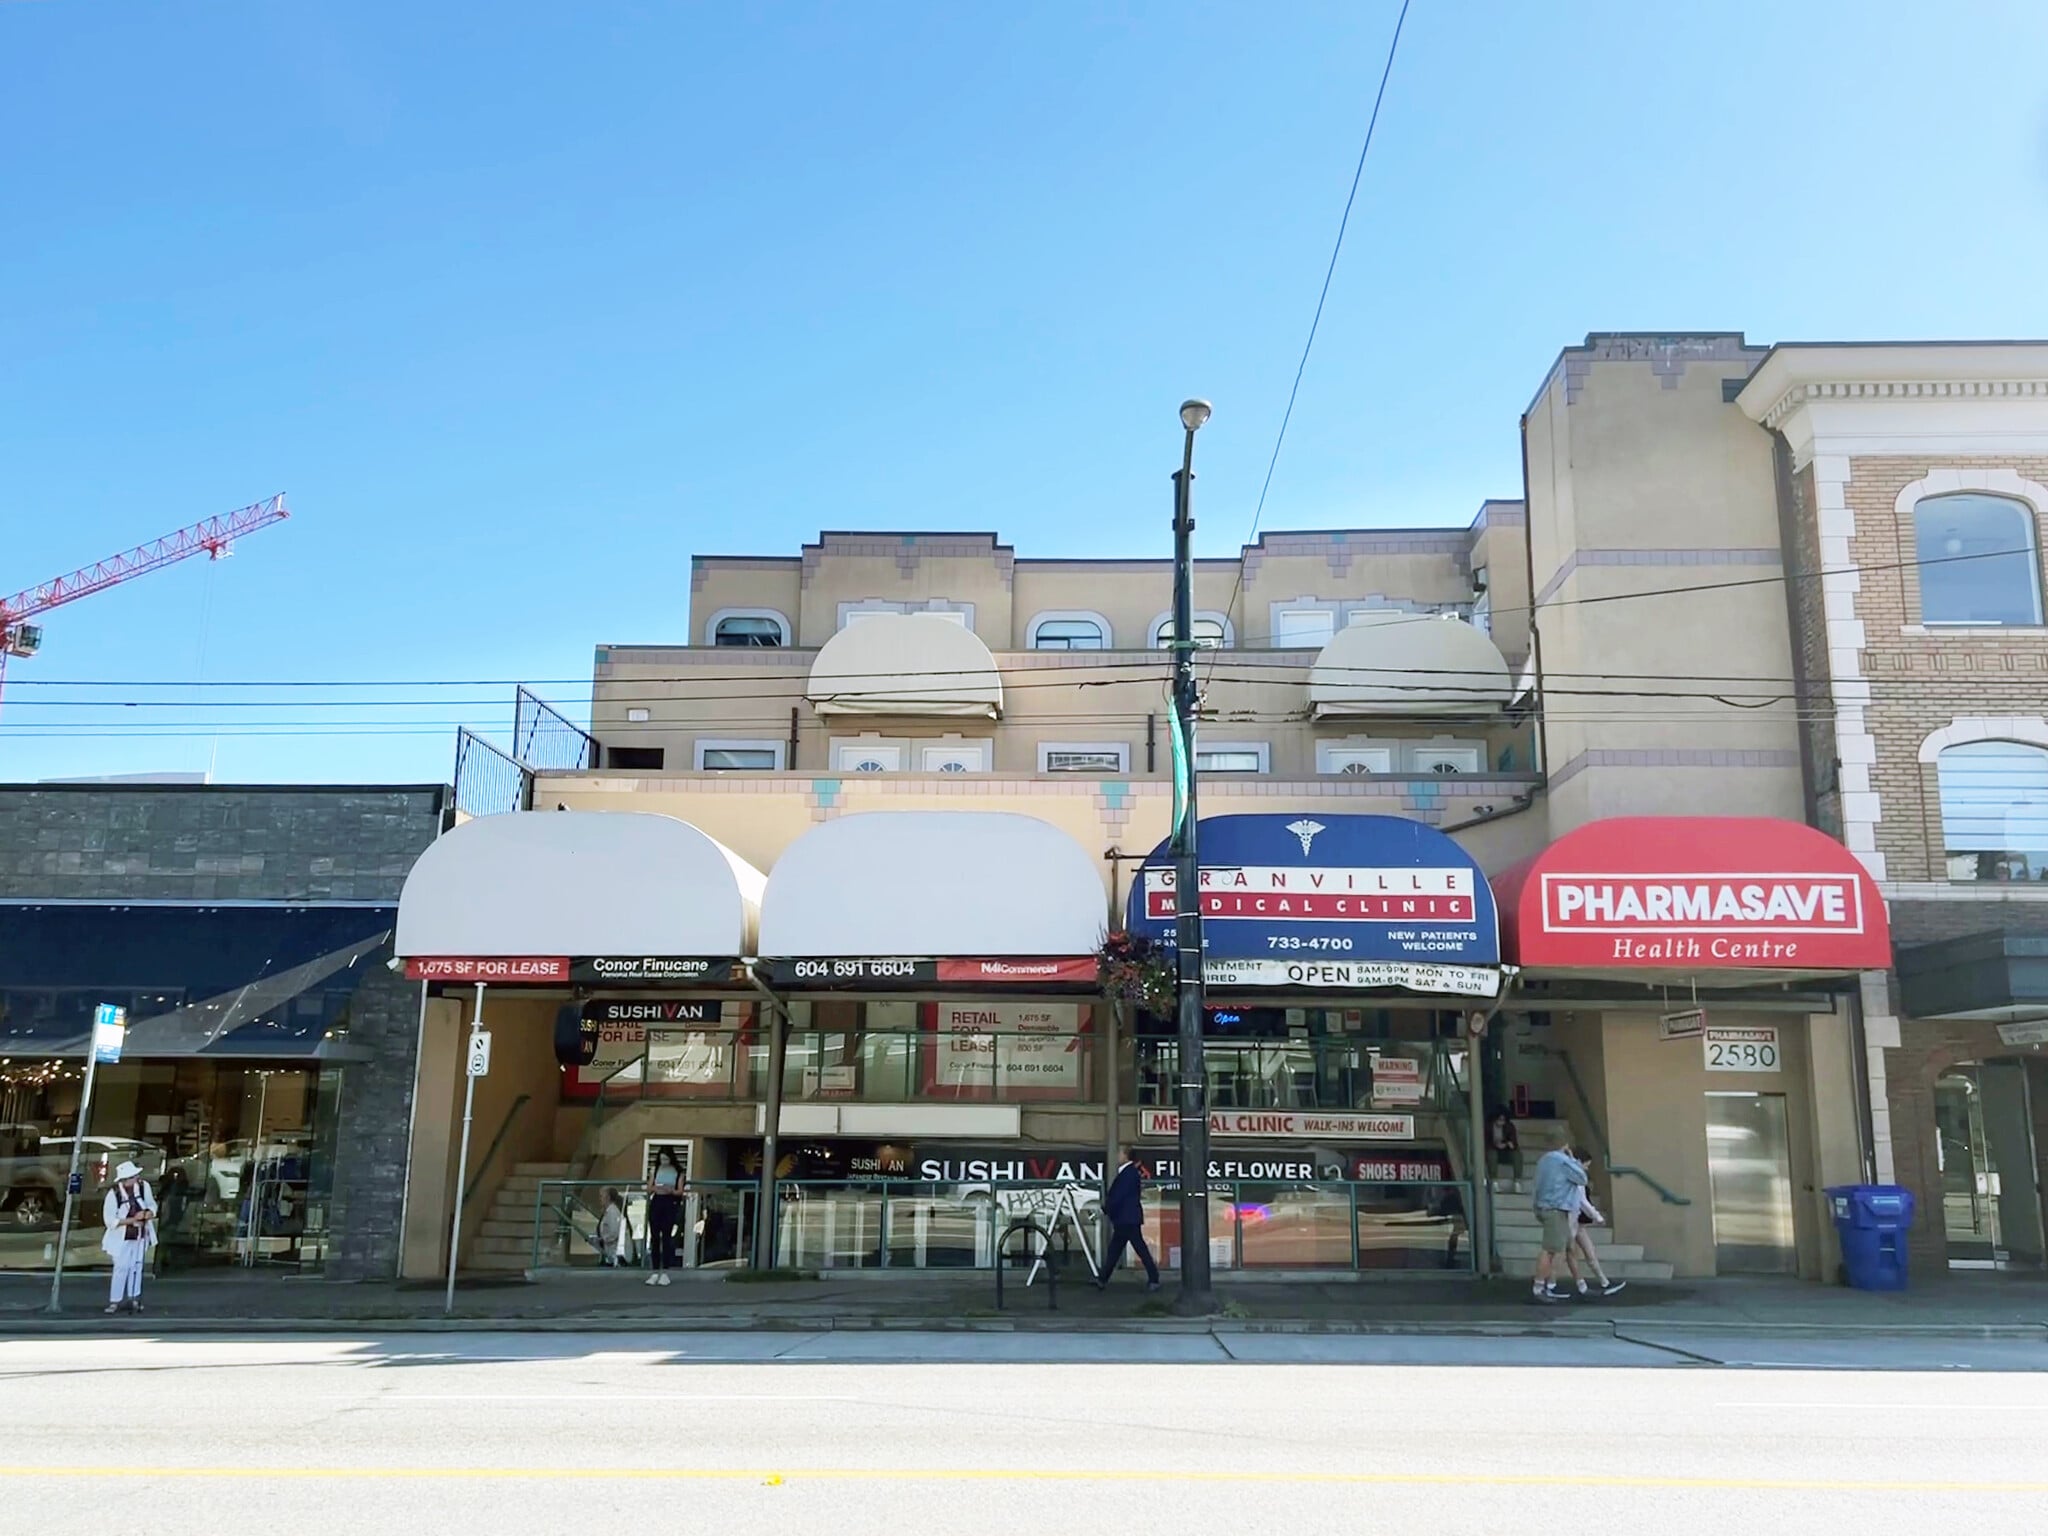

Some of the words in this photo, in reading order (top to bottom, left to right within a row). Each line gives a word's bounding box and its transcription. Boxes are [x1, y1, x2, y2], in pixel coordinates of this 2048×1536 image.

[1161, 872, 1456, 889] GRANVILLE
[1161, 898, 1313, 912] MDICAL
[1336, 900, 1460, 913] CLINIC
[1556, 884, 1847, 922] PHARMASAVE
[1267, 937, 1353, 949] 733-4700
[1388, 932, 1415, 940] NEW
[1421, 932, 1477, 941] PATIENTS
[1402, 942, 1464, 950] WELCOME
[1612, 938, 1701, 958] Health
[1711, 938, 1798, 958] Centre
[455, 961, 474, 974] SF
[477, 962, 507, 974] FOR
[511, 962, 559, 975] LEASE
[593, 958, 639, 972] Conor
[642, 958, 709, 972] Finucane
[795, 961, 829, 977] 604
[833, 960, 863, 976] 691
[870, 960, 916, 976] 6604
[1205, 962, 1262, 971] INTMENT
[1288, 966, 1350, 983] OPEN
[1416, 968, 1443, 977] MON
[1450, 970, 1464, 978] TO
[1471, 973, 1489, 981] FRI
[1415, 979, 1436, 987] SAT
[1457, 982, 1482, 991] SUN
[951, 1011, 1001, 1024] RETAIL
[1214, 1012, 1240, 1024] Open
[627, 1031, 671, 1042] LESE
[951, 1040, 996, 1053] LEASE
[1708, 1043, 1776, 1067] 2580
[1006, 1064, 1022, 1072] 604
[1378, 1061, 1413, 1072] WARNING
[1152, 1114, 1230, 1132] MEAL
[1236, 1115, 1294, 1133] CLINIC
[1304, 1119, 1354, 1132] WALK-INS
[1357, 1120, 1404, 1133] WELCOME
[1224, 1161, 1313, 1180] FLOWER
[1358, 1163, 1396, 1180] SHOES
[1400, 1164, 1442, 1181] REPAIR
